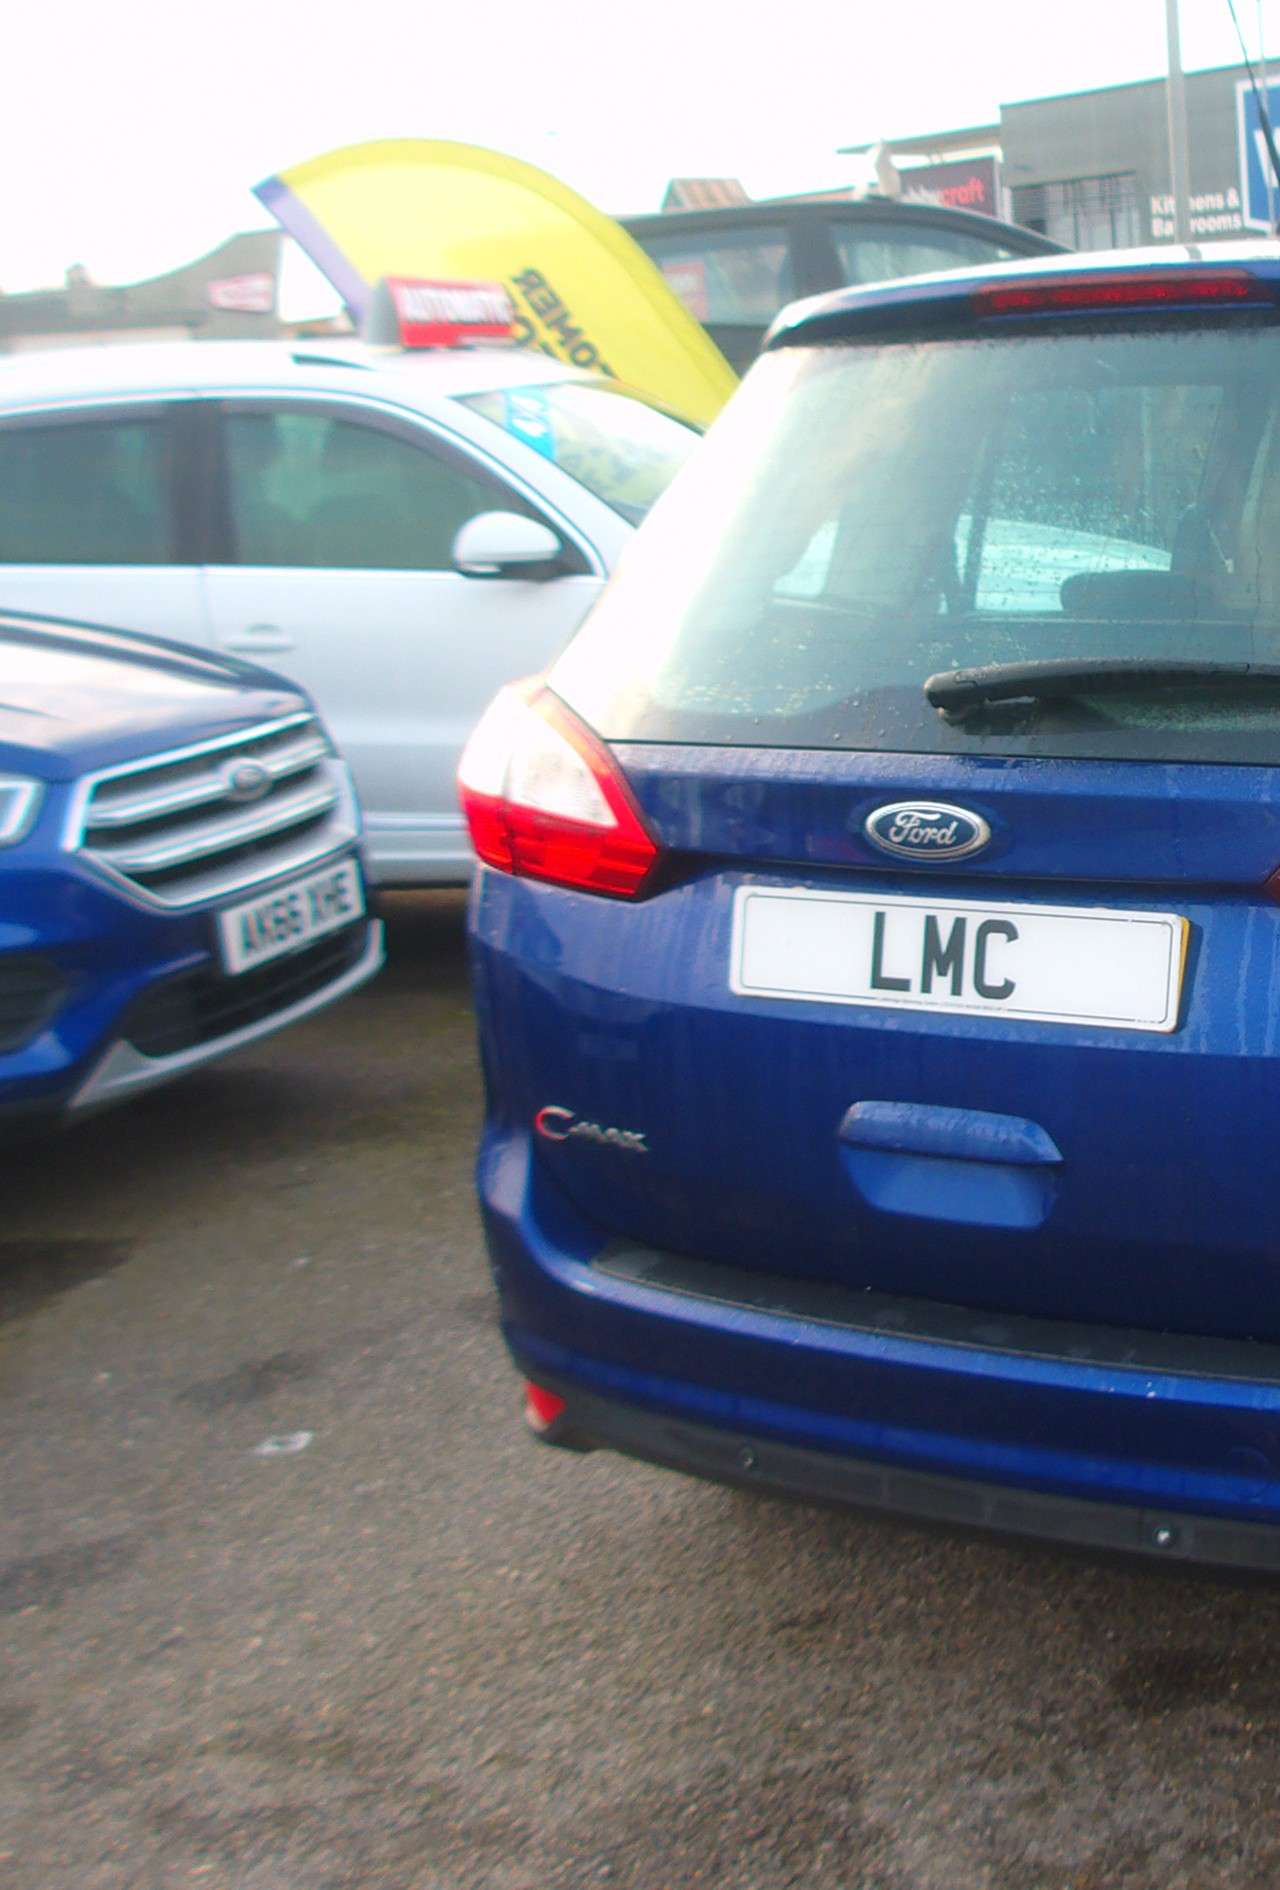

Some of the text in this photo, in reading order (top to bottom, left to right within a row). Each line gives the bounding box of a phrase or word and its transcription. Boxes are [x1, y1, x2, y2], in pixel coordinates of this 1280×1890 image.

[1151, 213, 1241, 237] Barooms
[890, 811, 959, 845] Ford
[870, 911, 1019, 1000] LMC
